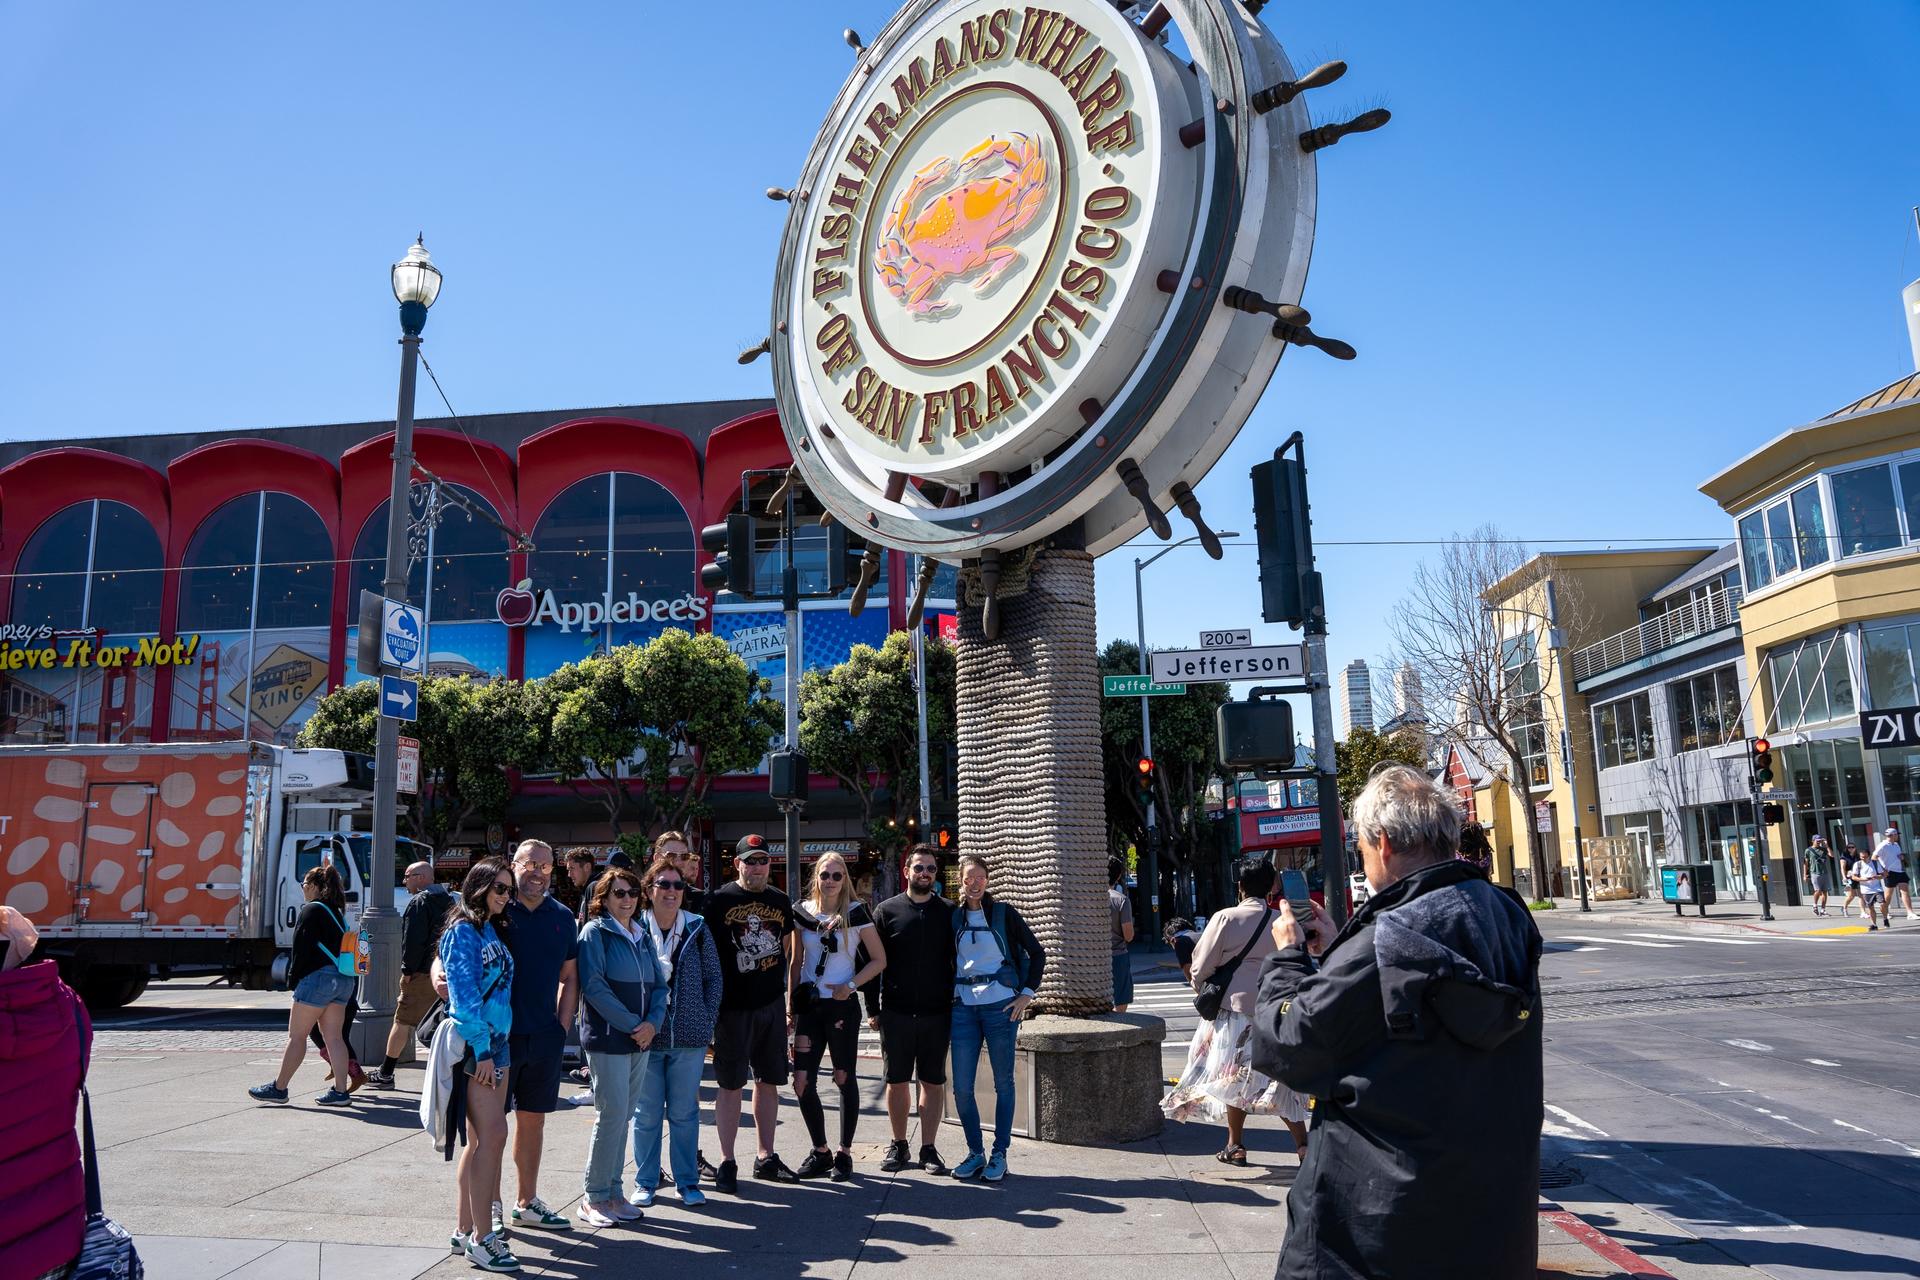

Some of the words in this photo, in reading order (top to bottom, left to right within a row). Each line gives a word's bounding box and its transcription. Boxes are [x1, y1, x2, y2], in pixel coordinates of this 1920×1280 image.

[812, 8, 1012, 299] FISHERMANS
[1014, 7, 1135, 153] WHARF
[816, 313, 862, 377] OF
[841, 366, 917, 442] SAN
[918, 186, 1131, 444] FRANCISCO
[532, 588, 708, 633] Applebee's
[63, 640, 92, 668] It
[97, 646, 130, 668] or
[133, 634, 199, 667] Not!
[1205, 632, 1234, 646] 200
[1167, 656, 1290, 676] Jefferson
[258, 686, 303, 710] XING
[1283, 813, 1320, 822] SIGHTSEEIN
[803, 843, 850, 852] CENTRAL
